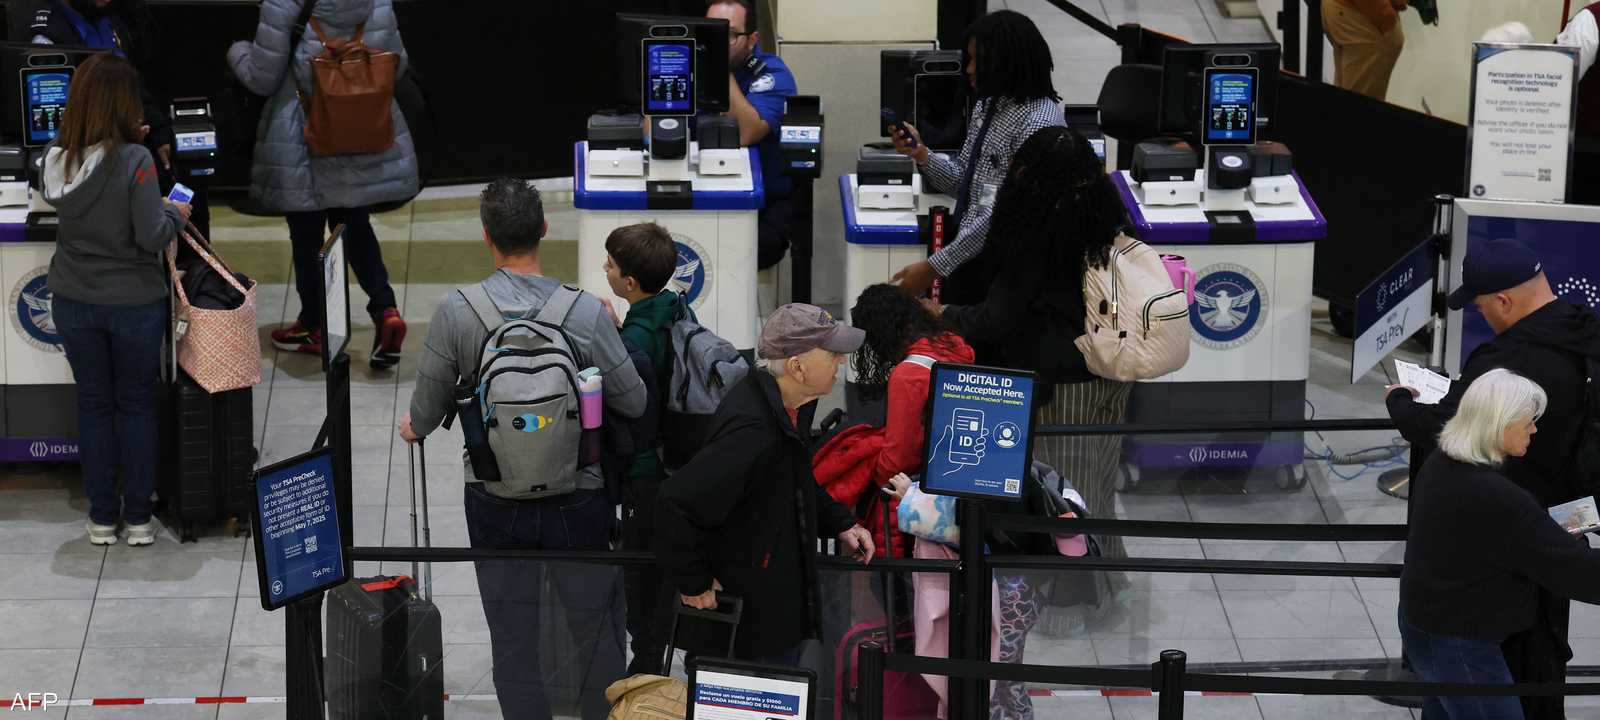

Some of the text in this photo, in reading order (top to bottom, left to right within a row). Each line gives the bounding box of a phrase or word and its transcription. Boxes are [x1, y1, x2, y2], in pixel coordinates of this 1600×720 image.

[1389, 268, 1414, 295] CLEAR
[1376, 332, 1388, 352] TSA
[944, 382, 1024, 398] Now Accepted Here.
[958, 373, 1012, 388] DIGITAL ID
[50, 445, 78, 454] IDEM
[960, 436, 972, 446] ID
[1210, 450, 1248, 459] IDEMIA
[264, 489, 288, 502] privileges
[289, 485, 300, 493] may
[308, 476, 324, 486] denied
[278, 494, 296, 505] subject
[302, 482, 326, 496] additional
[264, 507, 282, 518] security
[284, 498, 307, 510] measures
[312, 493, 322, 501] you
[268, 516, 276, 524] not
[278, 509, 296, 522] present
[300, 504, 314, 512] REAL
[266, 523, 279, 534] other
[280, 514, 305, 528] acceptable
[306, 511, 318, 519] form
[270, 526, 294, 540] beginning
[295, 521, 306, 530] May
[728, 698, 753, 706] MIEMBRO
[770, 704, 792, 712] FAMILIA
